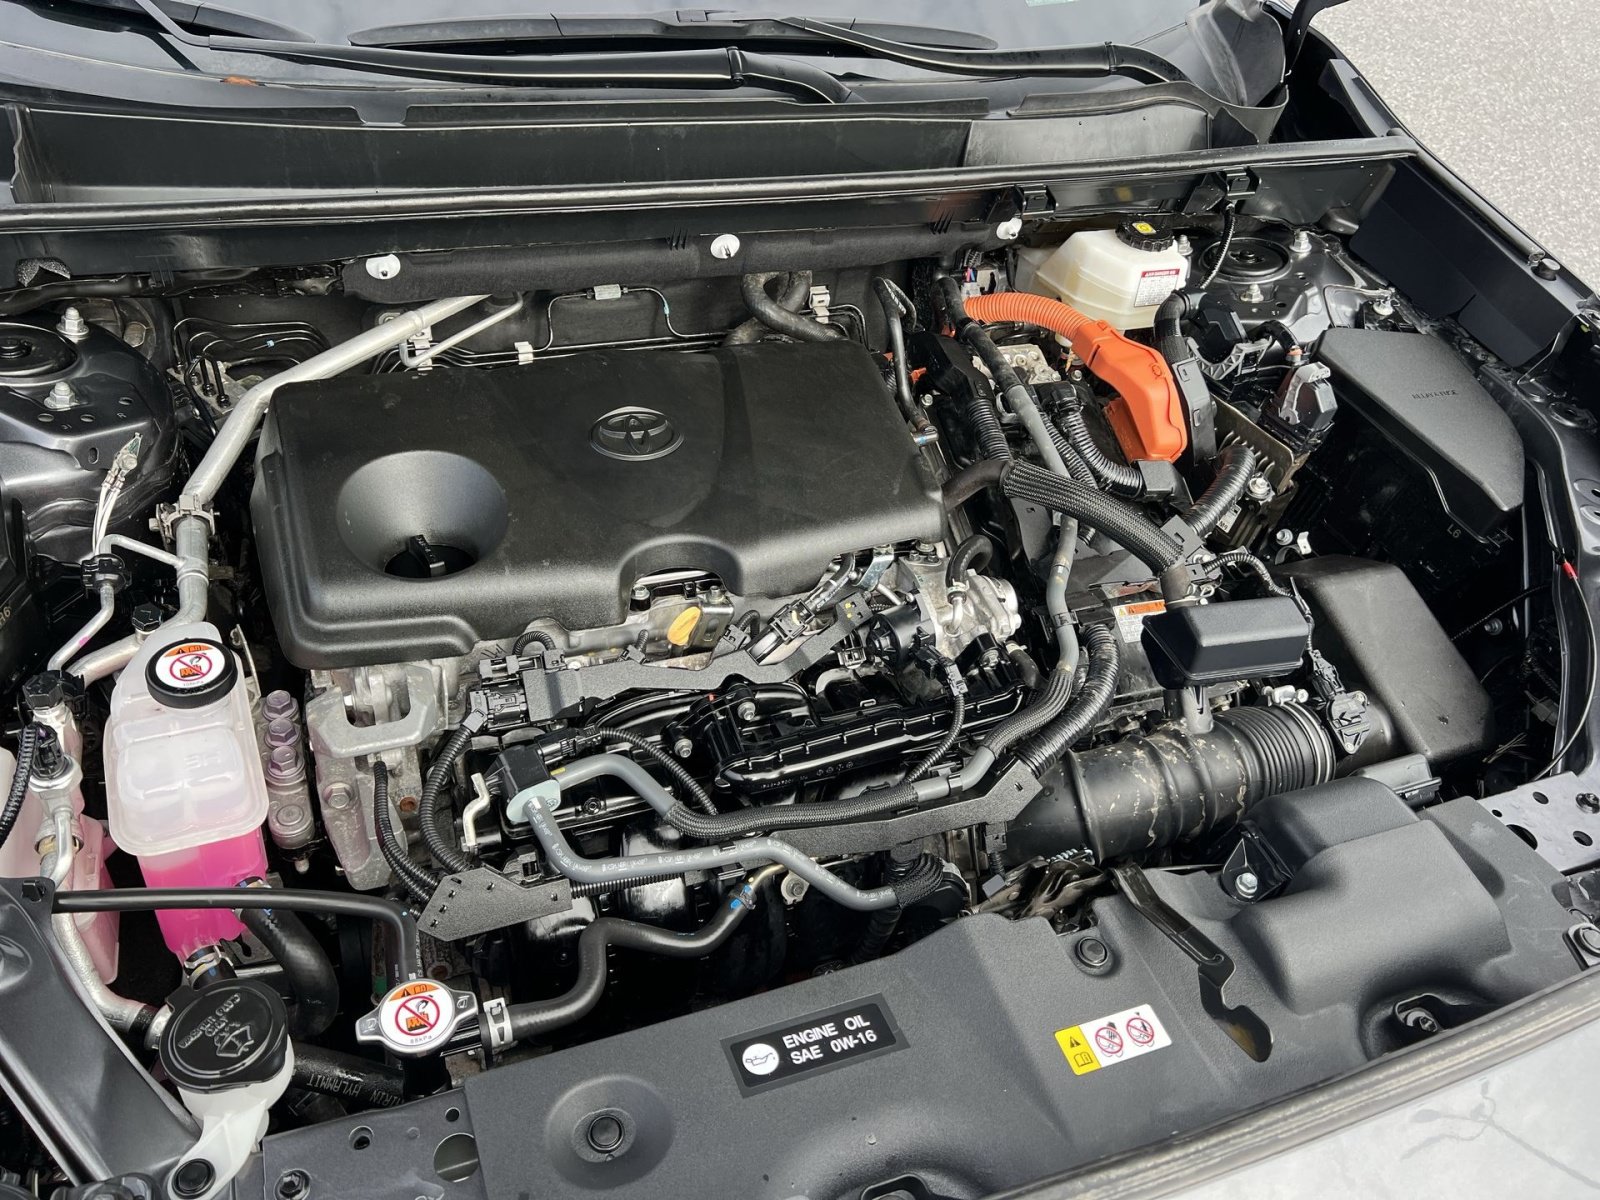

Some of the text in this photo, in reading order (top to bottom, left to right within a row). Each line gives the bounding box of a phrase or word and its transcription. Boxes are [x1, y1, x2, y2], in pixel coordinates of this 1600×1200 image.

[1447, 523, 1462, 538] L6
[782, 1014, 871, 1049] ENGINE OIL
[790, 1029, 878, 1065] SAE 0W-16
